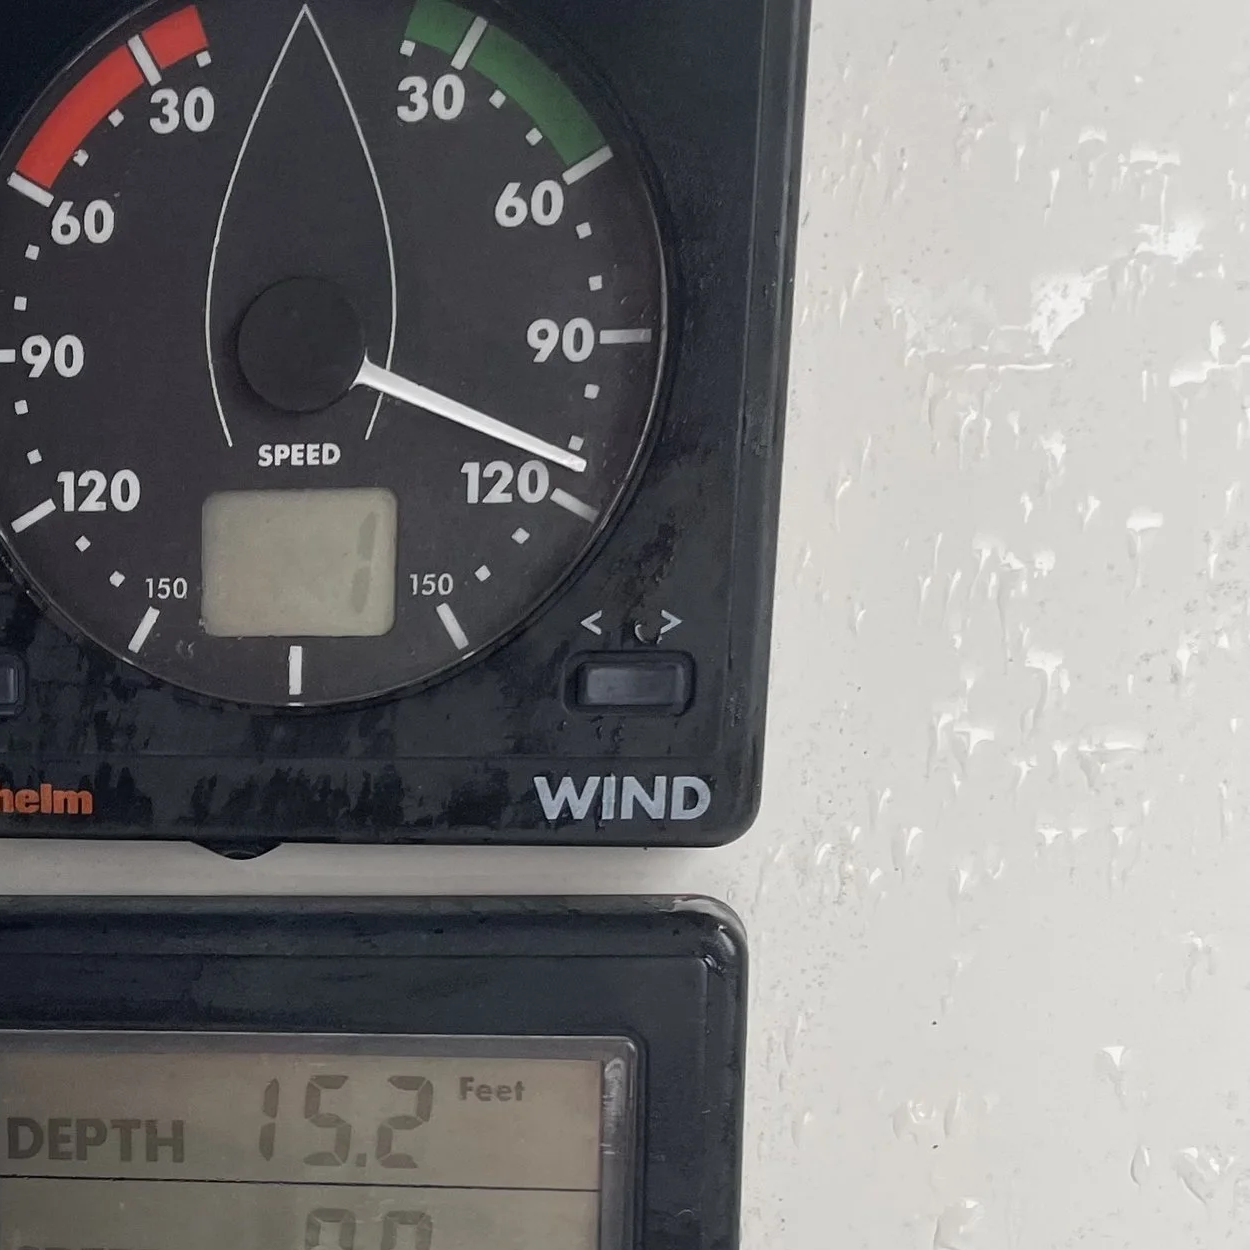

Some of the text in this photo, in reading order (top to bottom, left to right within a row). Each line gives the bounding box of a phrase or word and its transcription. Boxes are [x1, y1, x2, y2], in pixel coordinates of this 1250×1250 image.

[149, 86, 215, 134] 30
[396, 74, 465, 121] 30
[50, 201, 115, 245] 60
[494, 180, 564, 228] 60
[21, 334, 85, 378] 90
[526, 319, 595, 364] 90
[257, 444, 341, 468] SPEED
[56, 470, 141, 513] 120
[460, 461, 550, 504] 120
[144, 578, 189, 600] 150
[410, 574, 454, 597] 150
[533, 773, 712, 823] WIND
[7, 1074, 525, 1169] DEPTH 15.2 Feet
